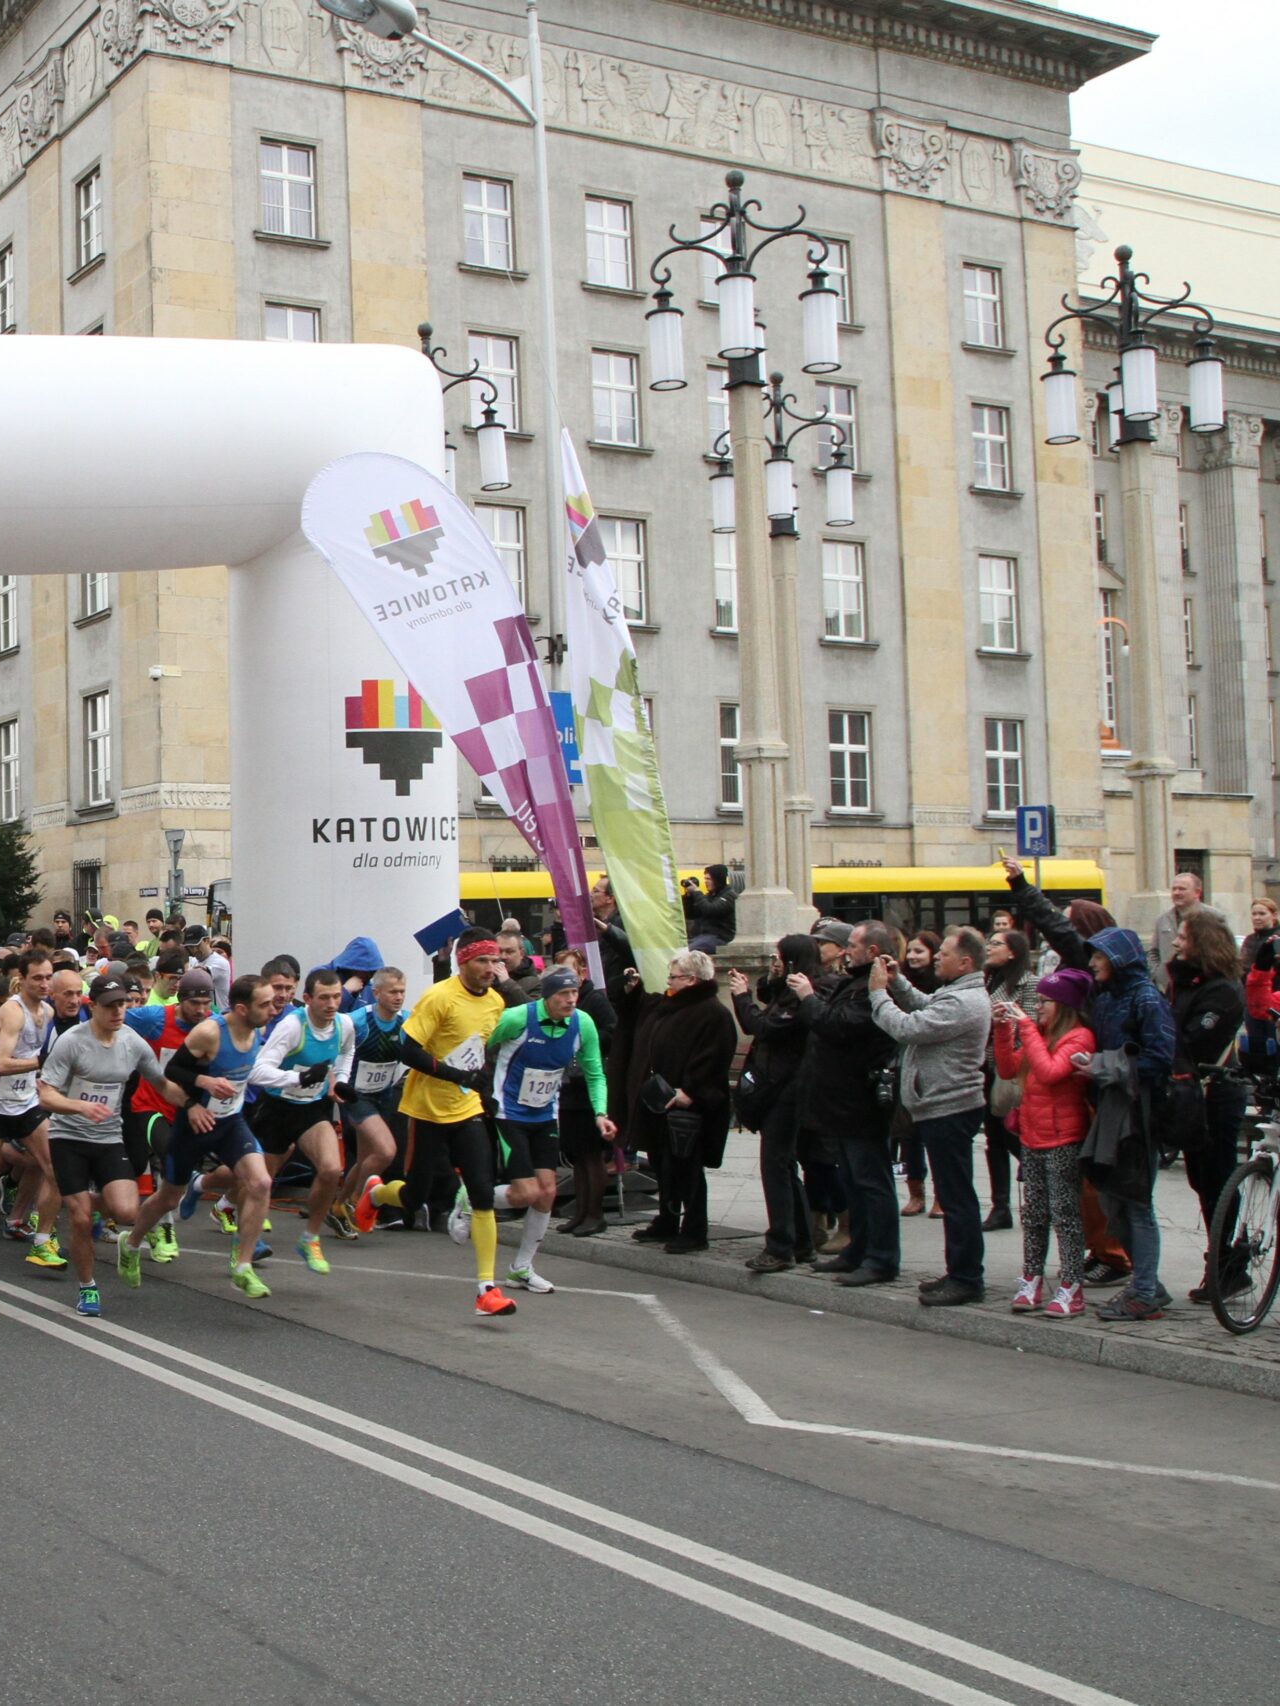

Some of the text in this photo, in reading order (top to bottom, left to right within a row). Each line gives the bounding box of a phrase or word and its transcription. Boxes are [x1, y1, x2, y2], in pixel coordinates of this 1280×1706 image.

[312, 816, 457, 843] KATOWICE
[1024, 810, 1042, 849] P
[352, 851, 442, 870] dla odmiany
[12, 1079, 27, 1091] 44
[367, 1071, 388, 1083] 706
